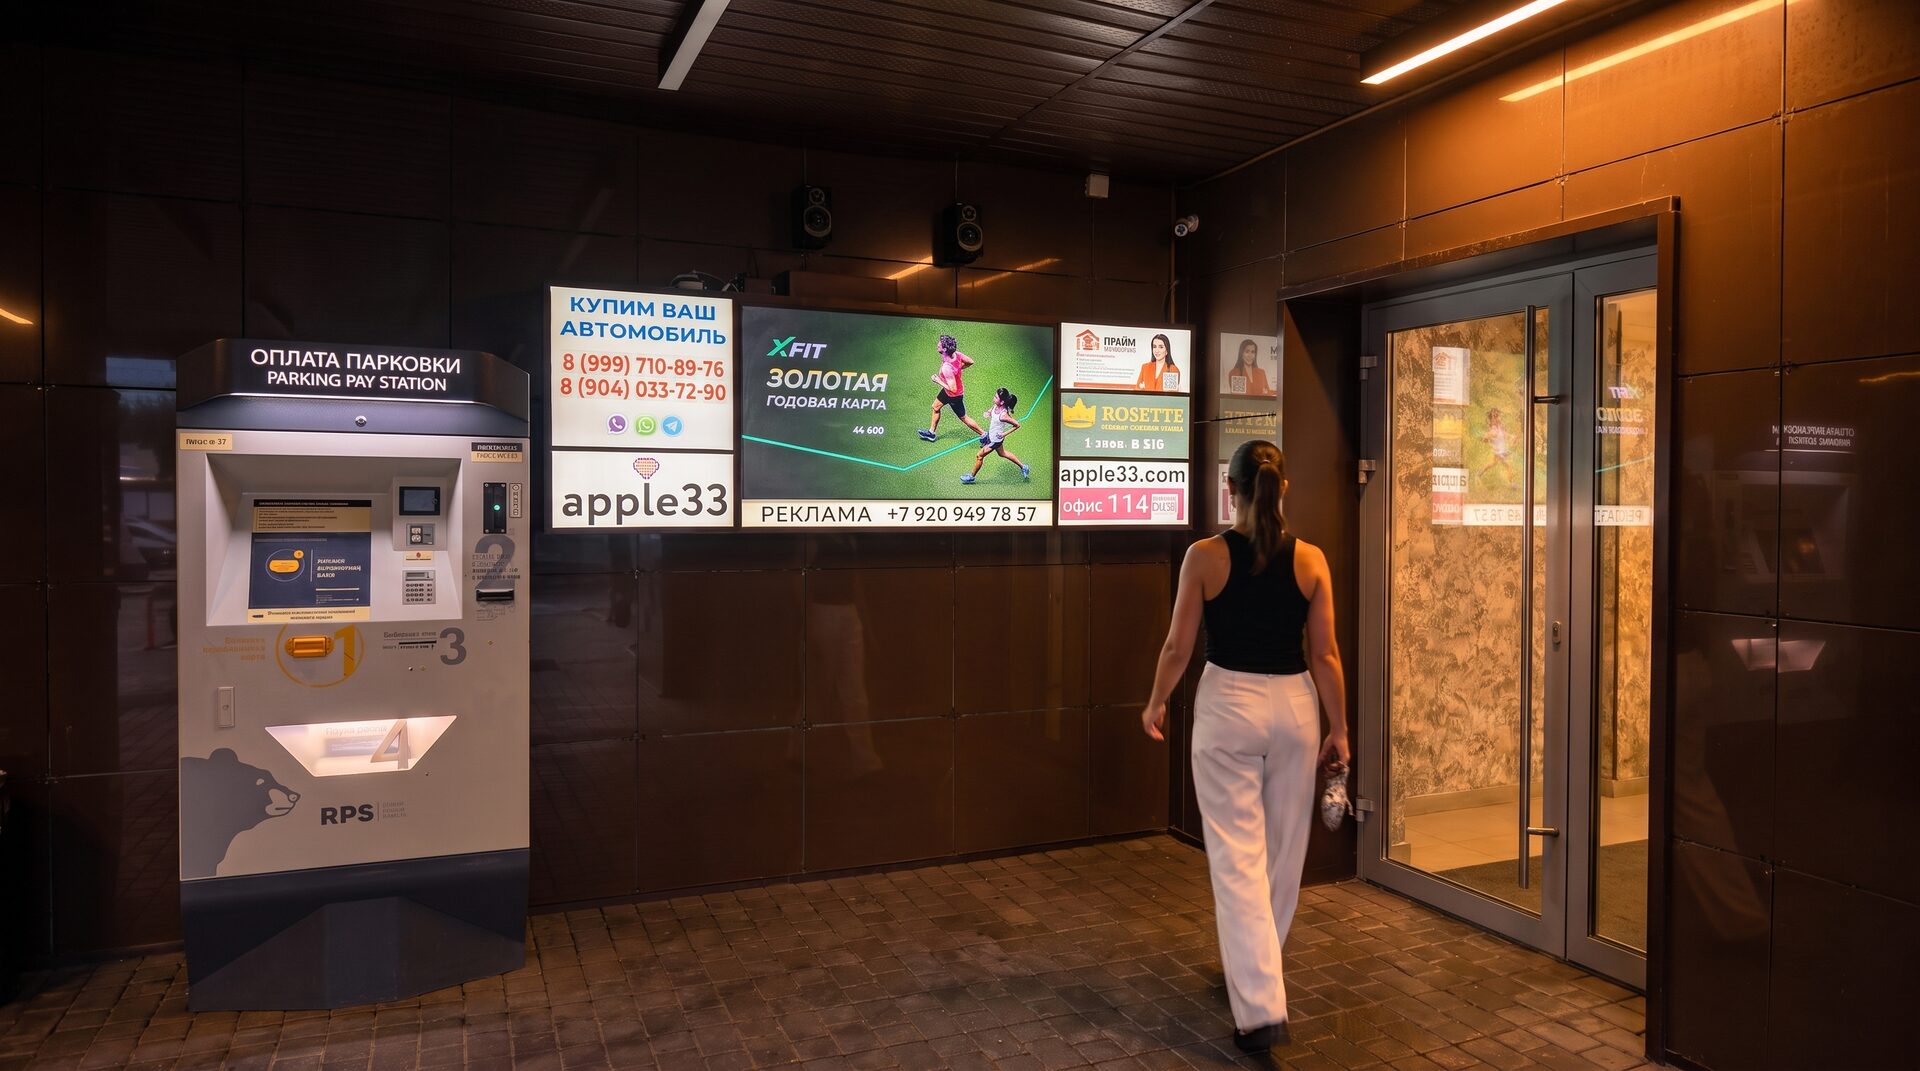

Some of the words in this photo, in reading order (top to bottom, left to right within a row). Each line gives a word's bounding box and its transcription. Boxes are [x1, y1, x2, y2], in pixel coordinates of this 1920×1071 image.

[570, 297, 655, 317] КУПИМ
[662, 303, 716, 321] ВАШ
[560, 320, 727, 344] АВТОМОБИЛЬ
[1104, 336, 1136, 347] ПРАЙМ
[766, 336, 827, 359] XFIT
[251, 349, 340, 369] ОПЛАТА
[346, 353, 461, 374] ПАРКОВКИ
[562, 353, 575, 370] 8
[580, 353, 631, 376] (999)
[636, 357, 724, 377] 710-89-76
[267, 371, 341, 387] PARKING
[346, 374, 375, 388] PAY
[380, 376, 447, 391] STATION
[560, 378, 572, 395] 8
[578, 377, 630, 400] (904)
[635, 381, 727, 401] 033-72-90
[766, 367, 889, 393] ЗОЛОТАЯ
[766, 395, 838, 410] ГОДОВАЯ
[841, 398, 887, 410] КАРТА
[1102, 406, 1184, 423] ROSETTE
[866, 425, 884, 435] 600
[1084, 437, 1092, 448] 1
[1061, 465, 1186, 487] apple33.com
[562, 482, 728, 526] apple33
[761, 506, 872, 522] РЕКЛАМА
[888, 506, 910, 522] +7
[914, 506, 948, 522] 920
[953, 506, 986, 522] 949
[991, 506, 1014, 522] 78
[1017, 506, 1036, 522] 57
[1063, 498, 1103, 516] офис
[1107, 494, 1149, 513] 114
[475, 535, 516, 591] 2
[333, 624, 356, 677] 1
[440, 627, 467, 665] 3
[370, 719, 409, 770] 4
[321, 804, 374, 826] RPS
